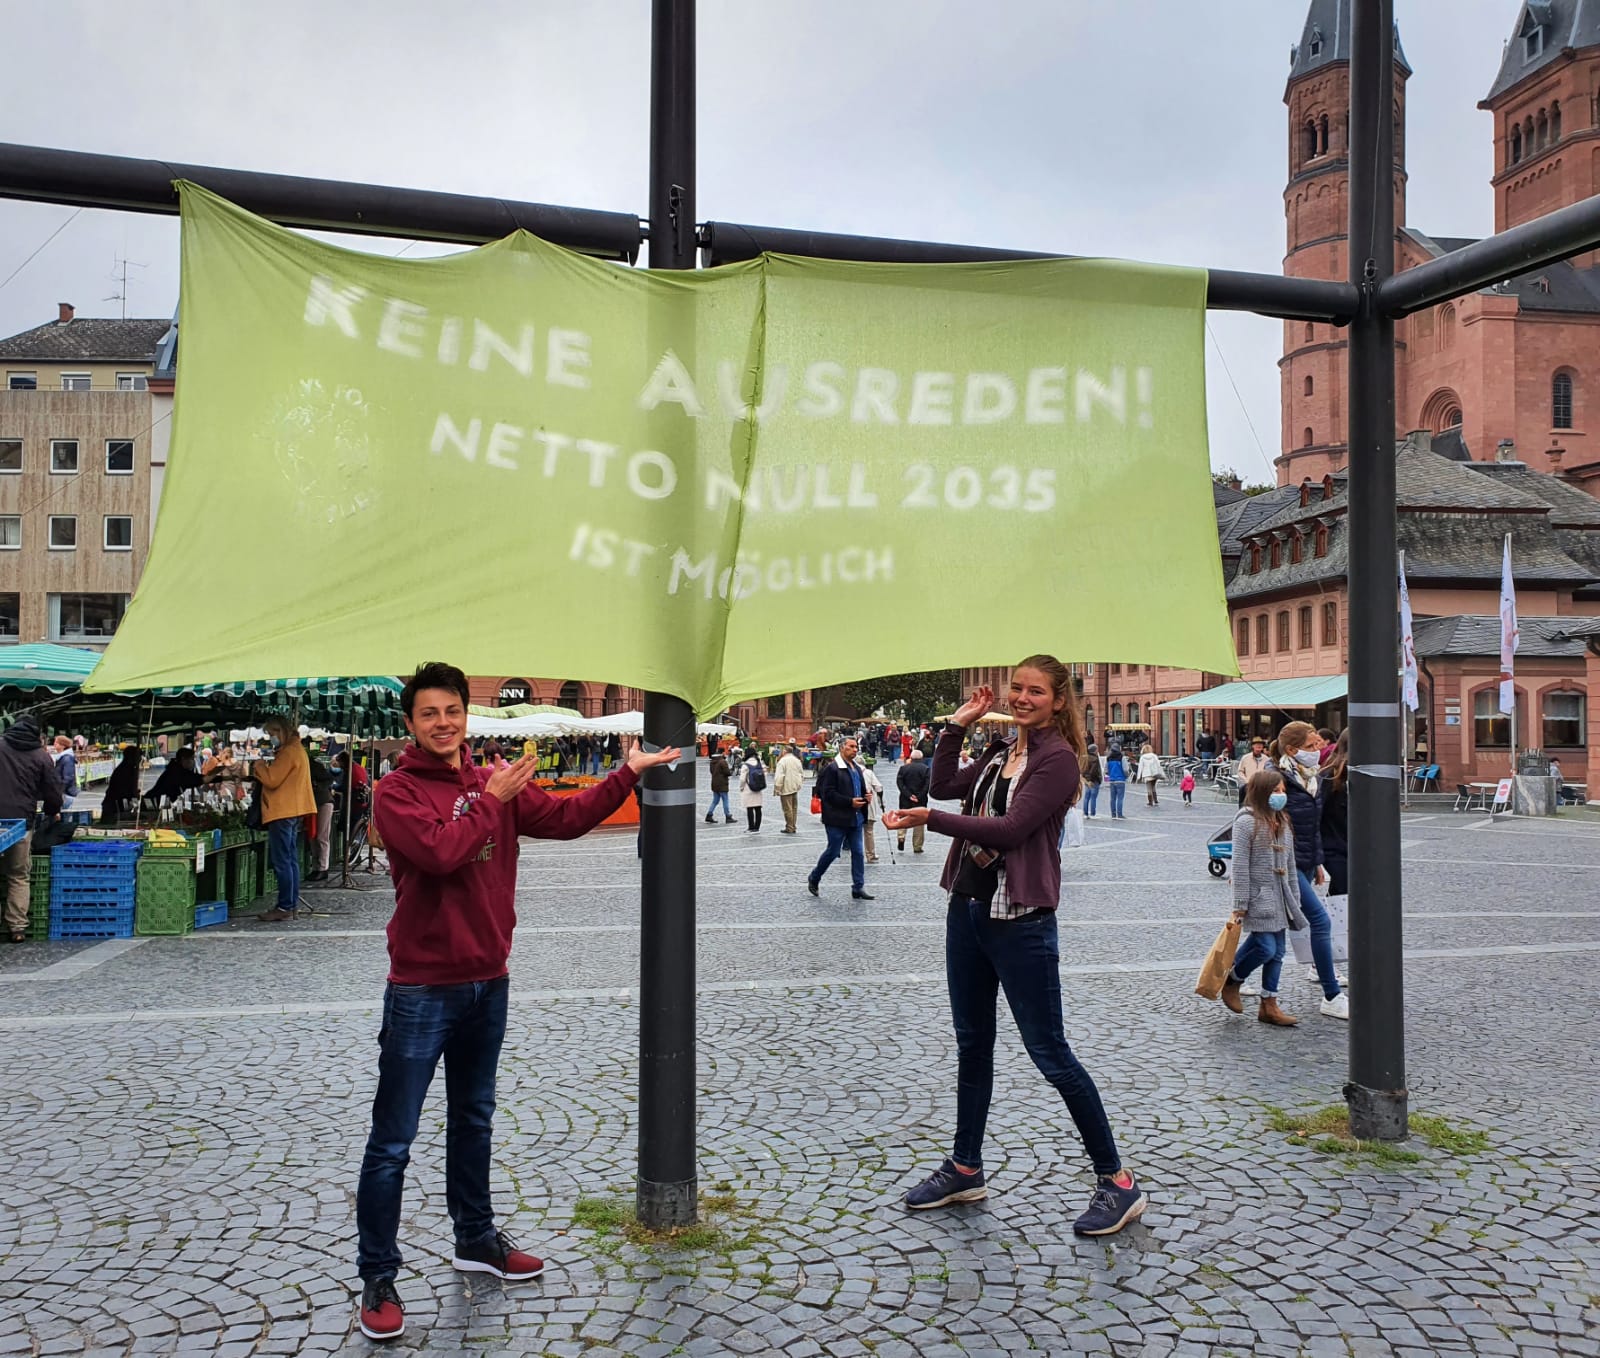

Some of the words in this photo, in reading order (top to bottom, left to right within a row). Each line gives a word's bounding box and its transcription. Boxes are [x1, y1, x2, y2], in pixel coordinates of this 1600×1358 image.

[303, 272, 593, 390] KEINE
[637, 347, 1155, 429] AUSREDEN!
[429, 412, 679, 500] NETTO
[705, 462, 879, 512] NULL
[901, 462, 1058, 512] 2035
[568, 523, 657, 577] IST
[666, 544, 895, 601] MÖGLICH
[498, 688, 525, 699] SINN
